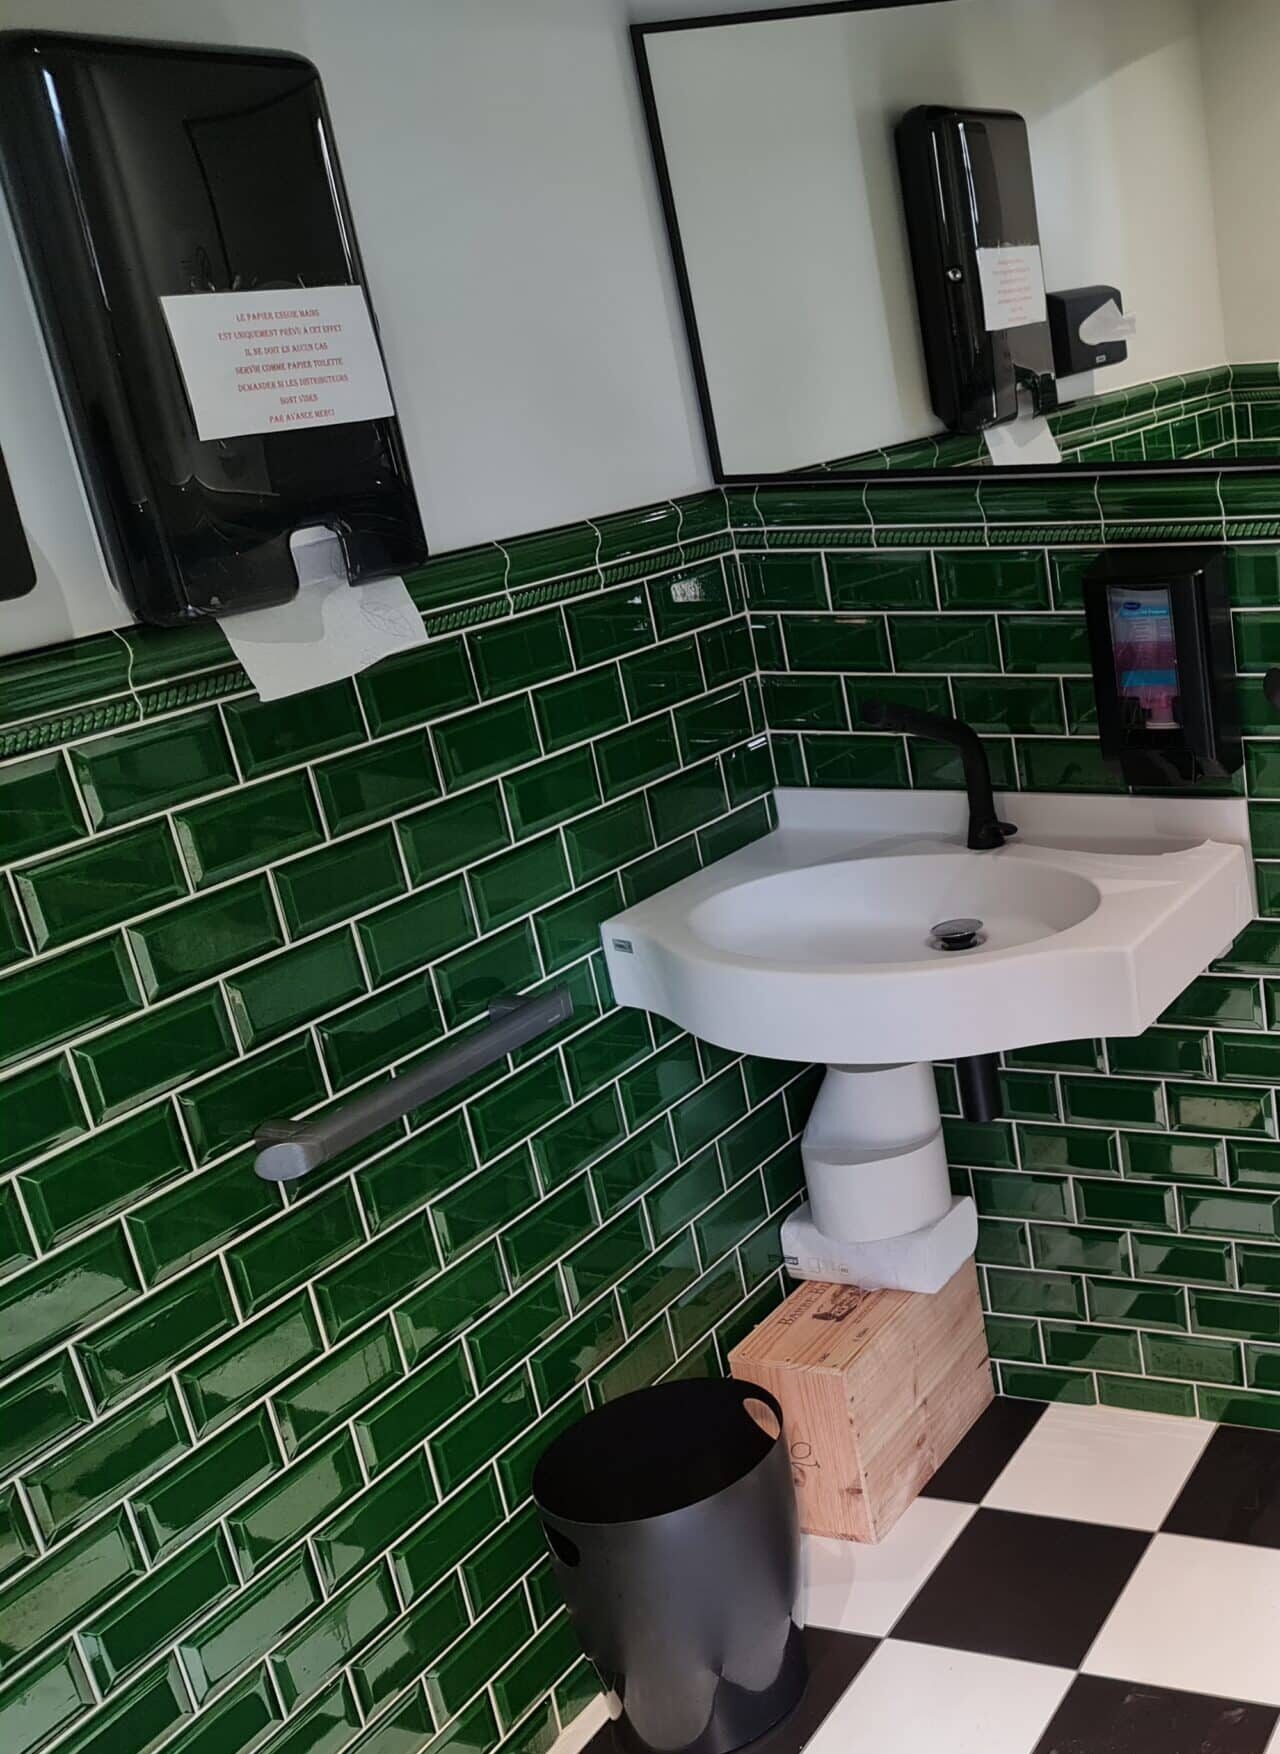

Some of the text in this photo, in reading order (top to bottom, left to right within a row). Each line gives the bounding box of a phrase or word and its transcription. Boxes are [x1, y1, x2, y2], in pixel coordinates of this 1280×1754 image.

[246, 311, 274, 321] PAPIER
[218, 331, 232, 340] EST
[234, 328, 278, 339] UNIQUEMENT
[322, 324, 342, 333] EFFET
[288, 360, 312, 370] PAPIER
